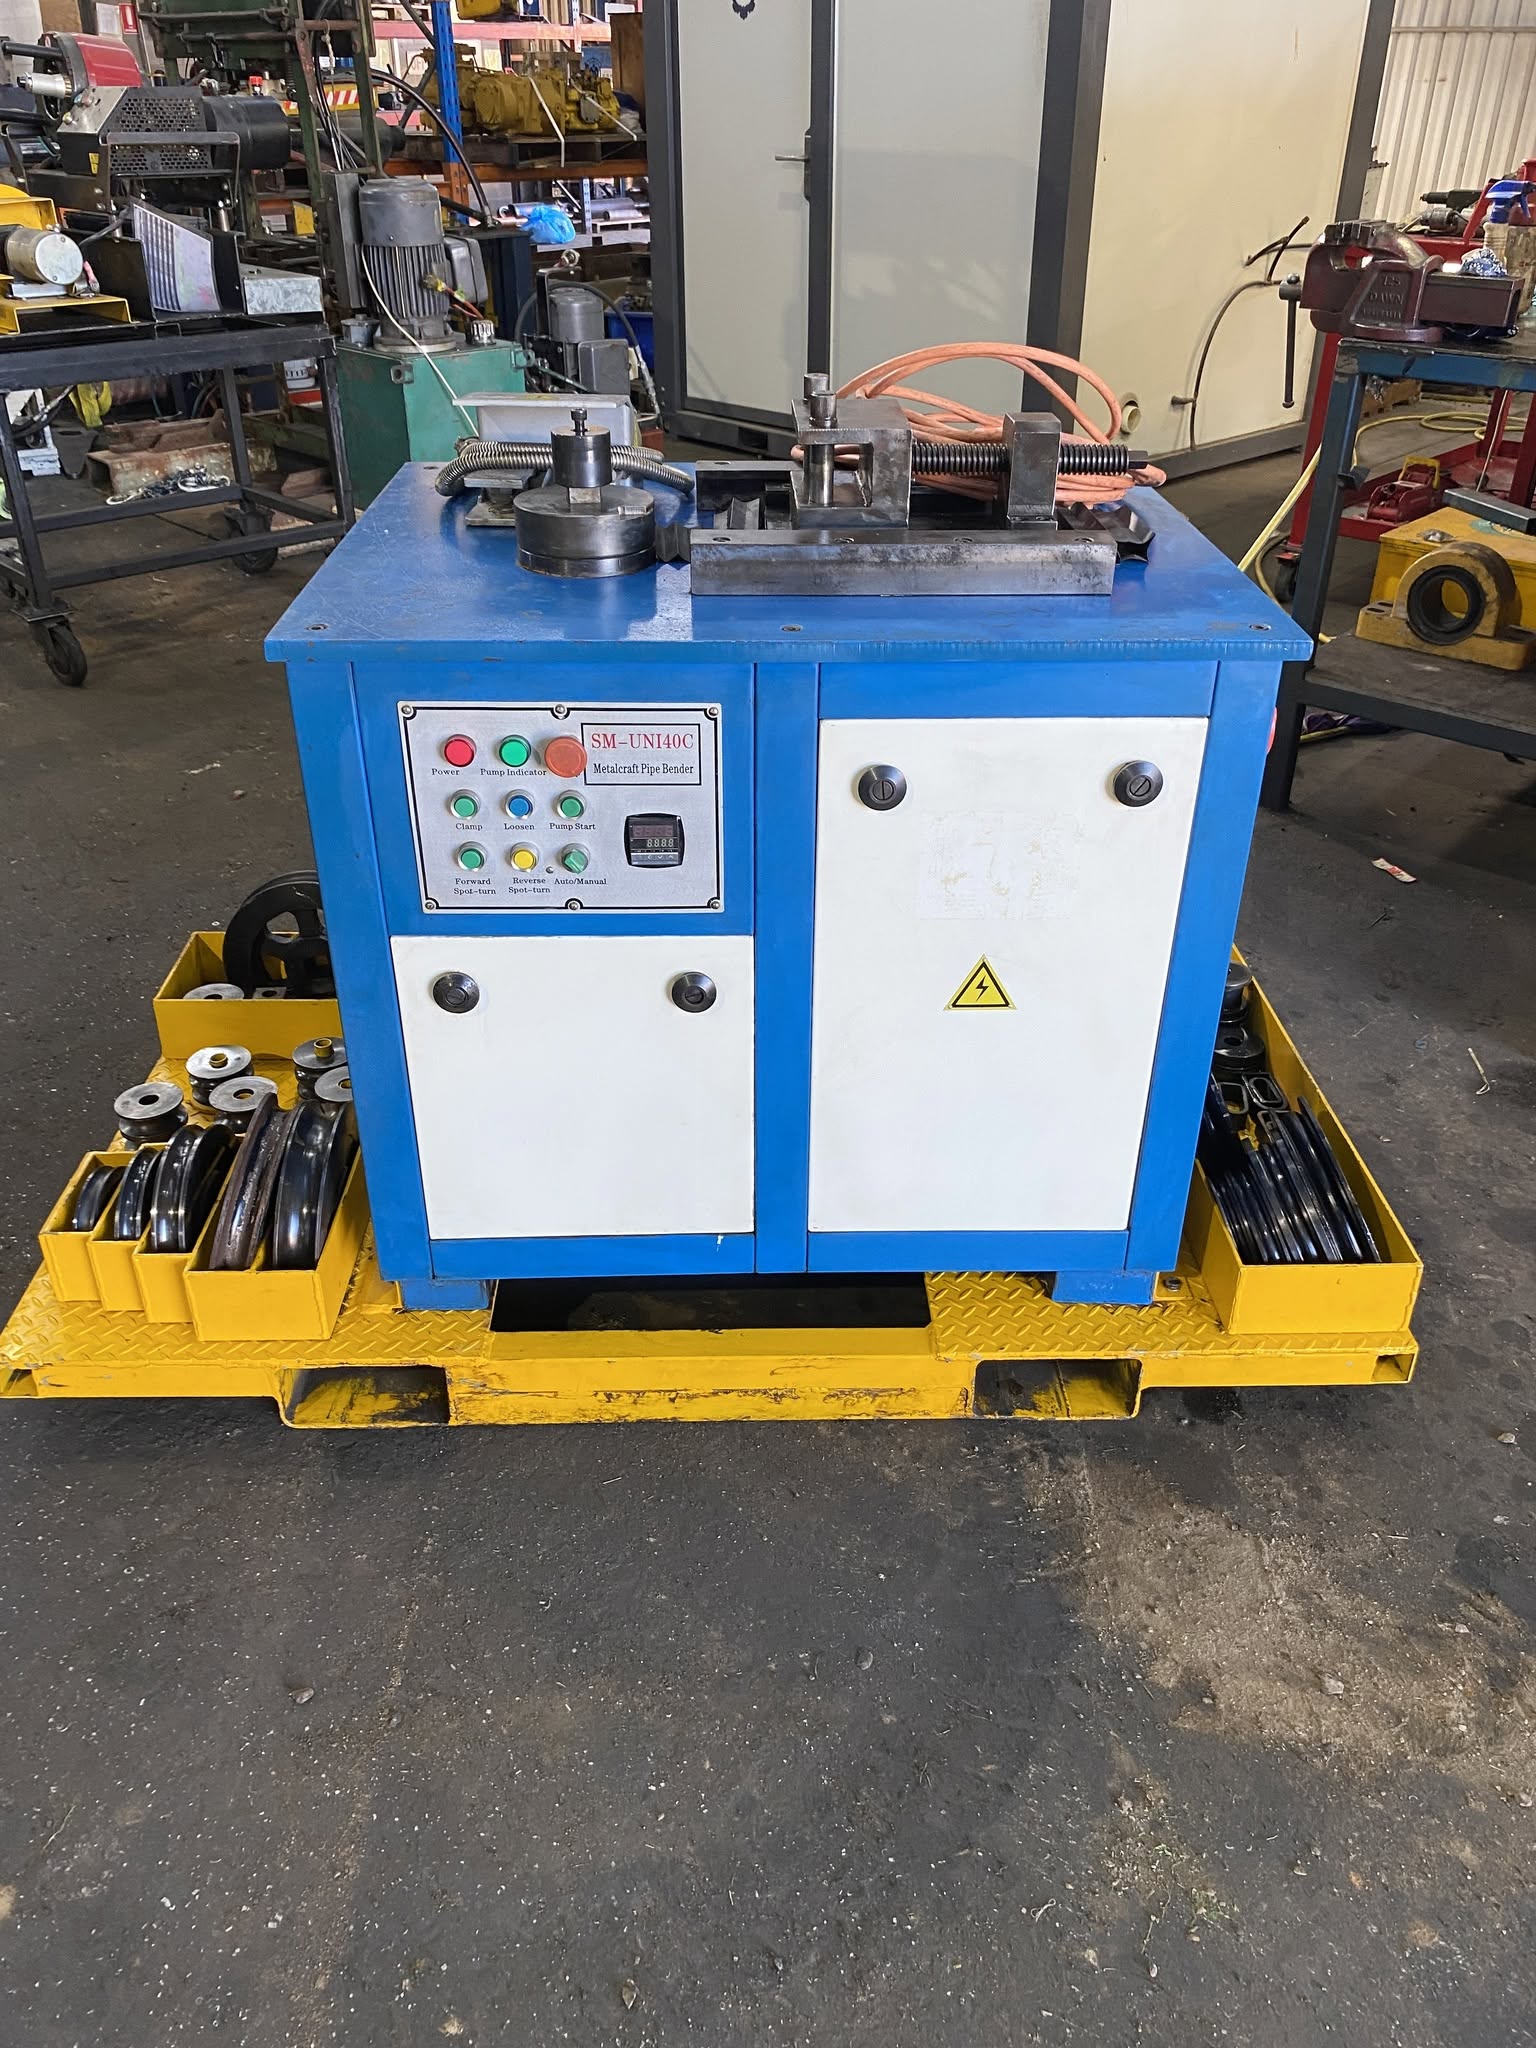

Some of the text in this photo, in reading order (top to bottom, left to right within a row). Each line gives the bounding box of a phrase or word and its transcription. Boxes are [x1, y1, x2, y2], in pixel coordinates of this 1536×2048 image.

[1369, 290, 1404, 305] DAWN
[591, 733, 694, 749] SM-UNI40C
[431, 768, 460, 776] Power
[480, 768, 547, 777] Pump Indicator
[593, 763, 694, 776] Metalcraft Pipe Bender
[455, 823, 483, 831] Clamp
[549, 823, 573, 831] Pump
[453, 887, 497, 896] Spot-turn
[508, 886, 551, 894] Spot-turn
